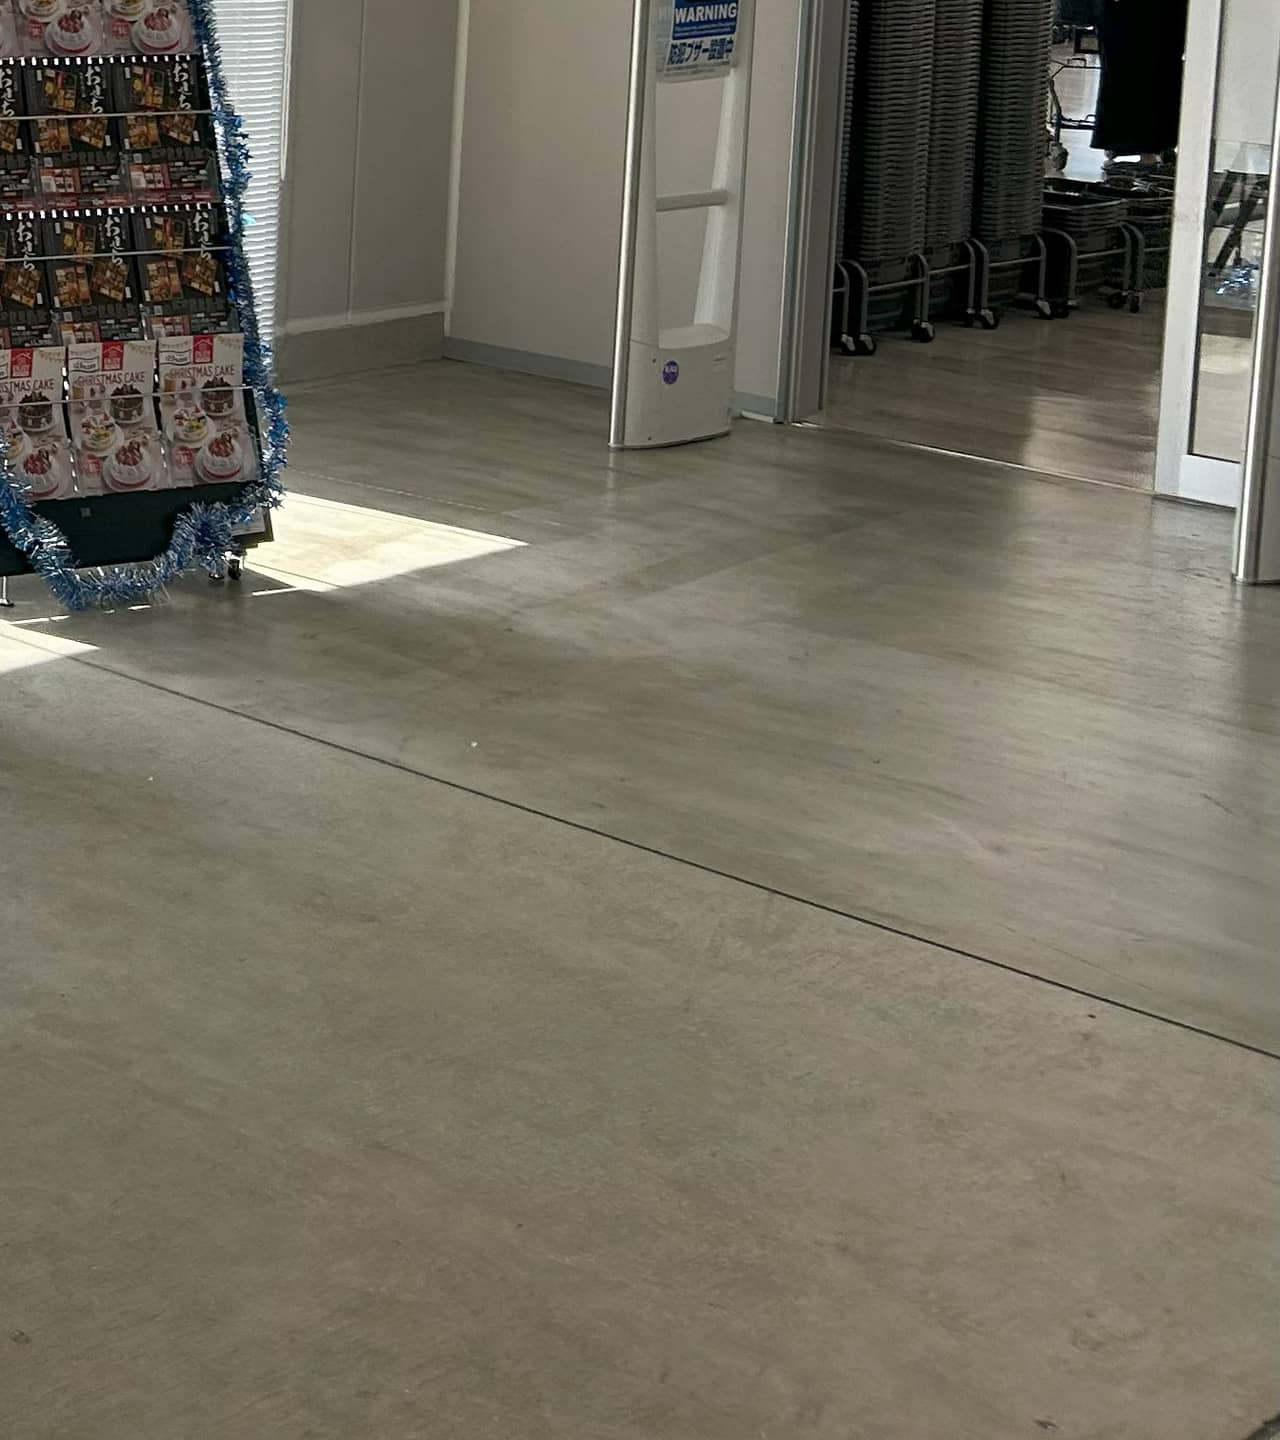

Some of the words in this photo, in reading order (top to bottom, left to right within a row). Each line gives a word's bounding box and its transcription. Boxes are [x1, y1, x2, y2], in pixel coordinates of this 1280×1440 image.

[675, 3, 737, 24] WARNING
[123, 371, 145, 383] CAKE
[33, 378, 54, 390] CAKE
